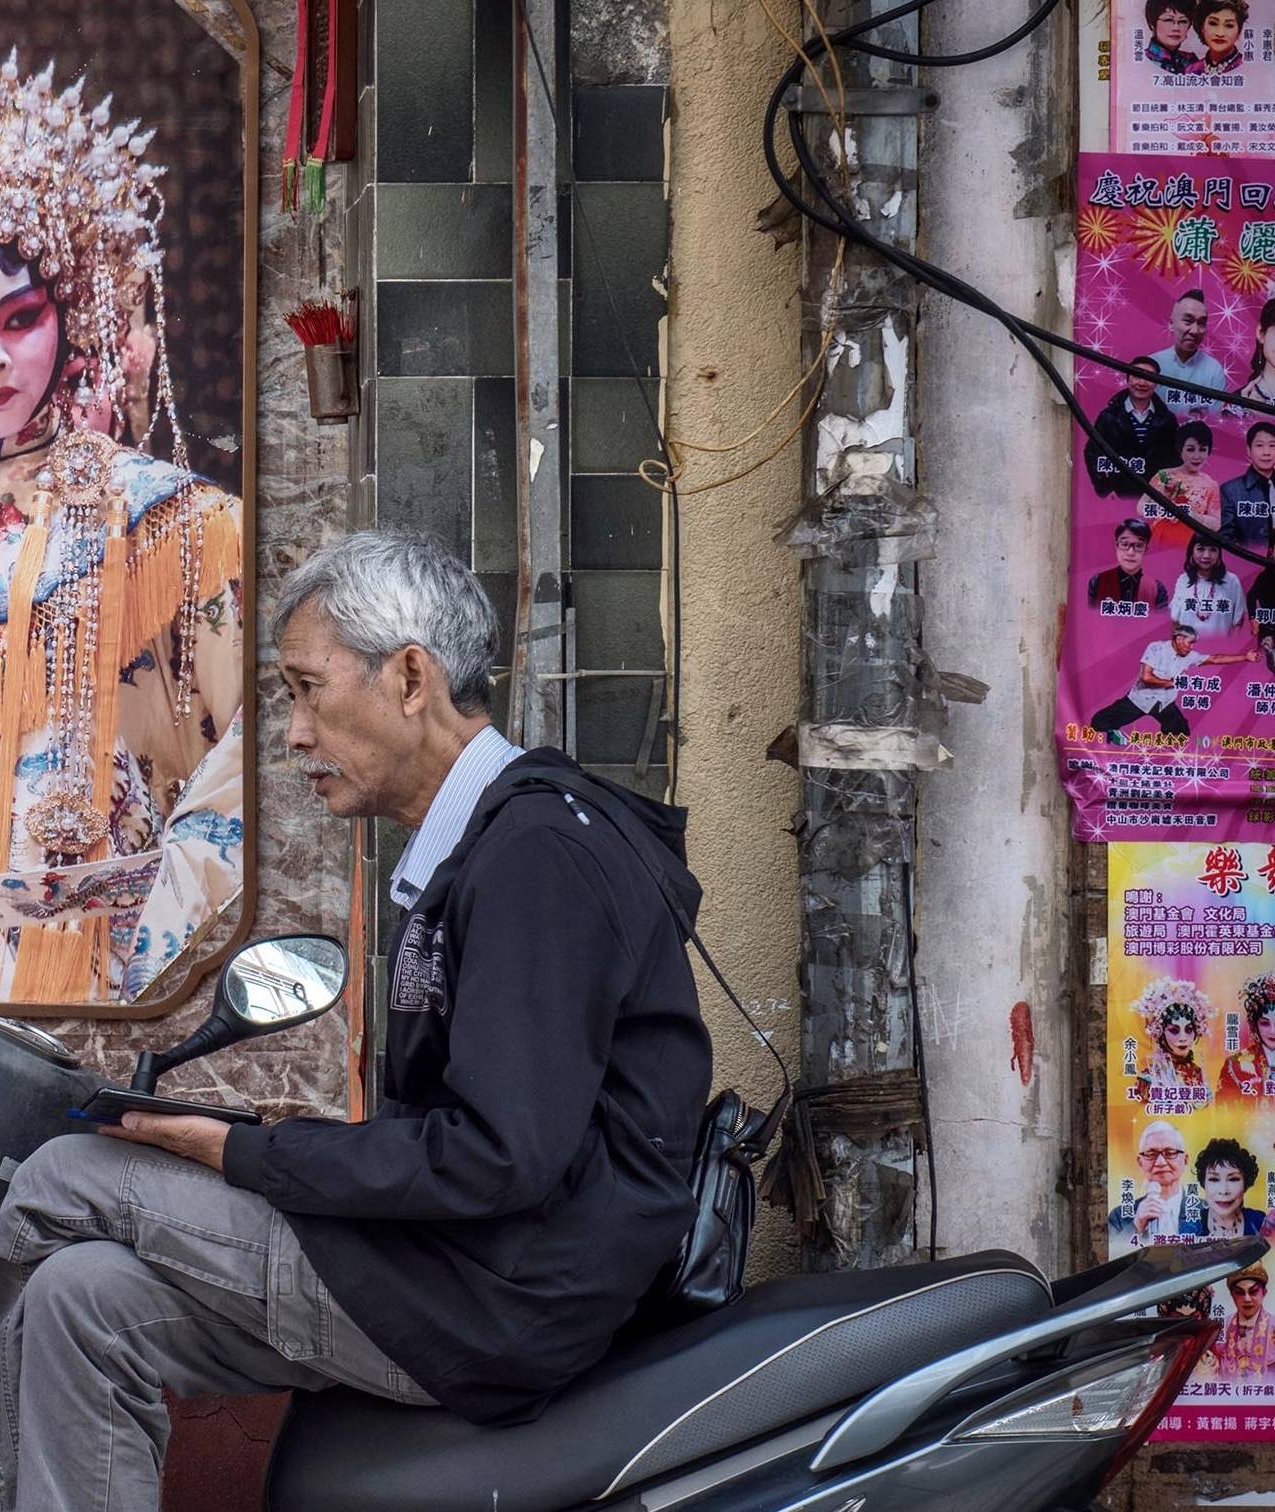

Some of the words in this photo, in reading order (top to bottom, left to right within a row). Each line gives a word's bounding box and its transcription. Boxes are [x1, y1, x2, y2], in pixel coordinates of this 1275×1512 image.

[1152, 75, 1245, 87] 7.高山流水會知音
[1167, 389, 1213, 405] 陳偉良
[1097, 456, 1145, 474] 陳鏡
[1101, 600, 1149, 618] 陳炳慶
[1174, 675, 1222, 692] 楊有成
[1181, 695, 1210, 710] 師傅
[1129, 729, 1189, 748] 澳門基金會
[1123, 889, 1163, 905] 鳴謝：
[1124, 906, 1194, 922] 澳門基金會
[1204, 906, 1247, 922] 文化局
[1124, 923, 1167, 939] 旅遊局
[1176, 923, 1275, 939] 澳門霍英東基金
[1124, 941, 1263, 956] 澳門博彩股份有限公司
[1123, 1035, 1137, 1076] 余小鳳
